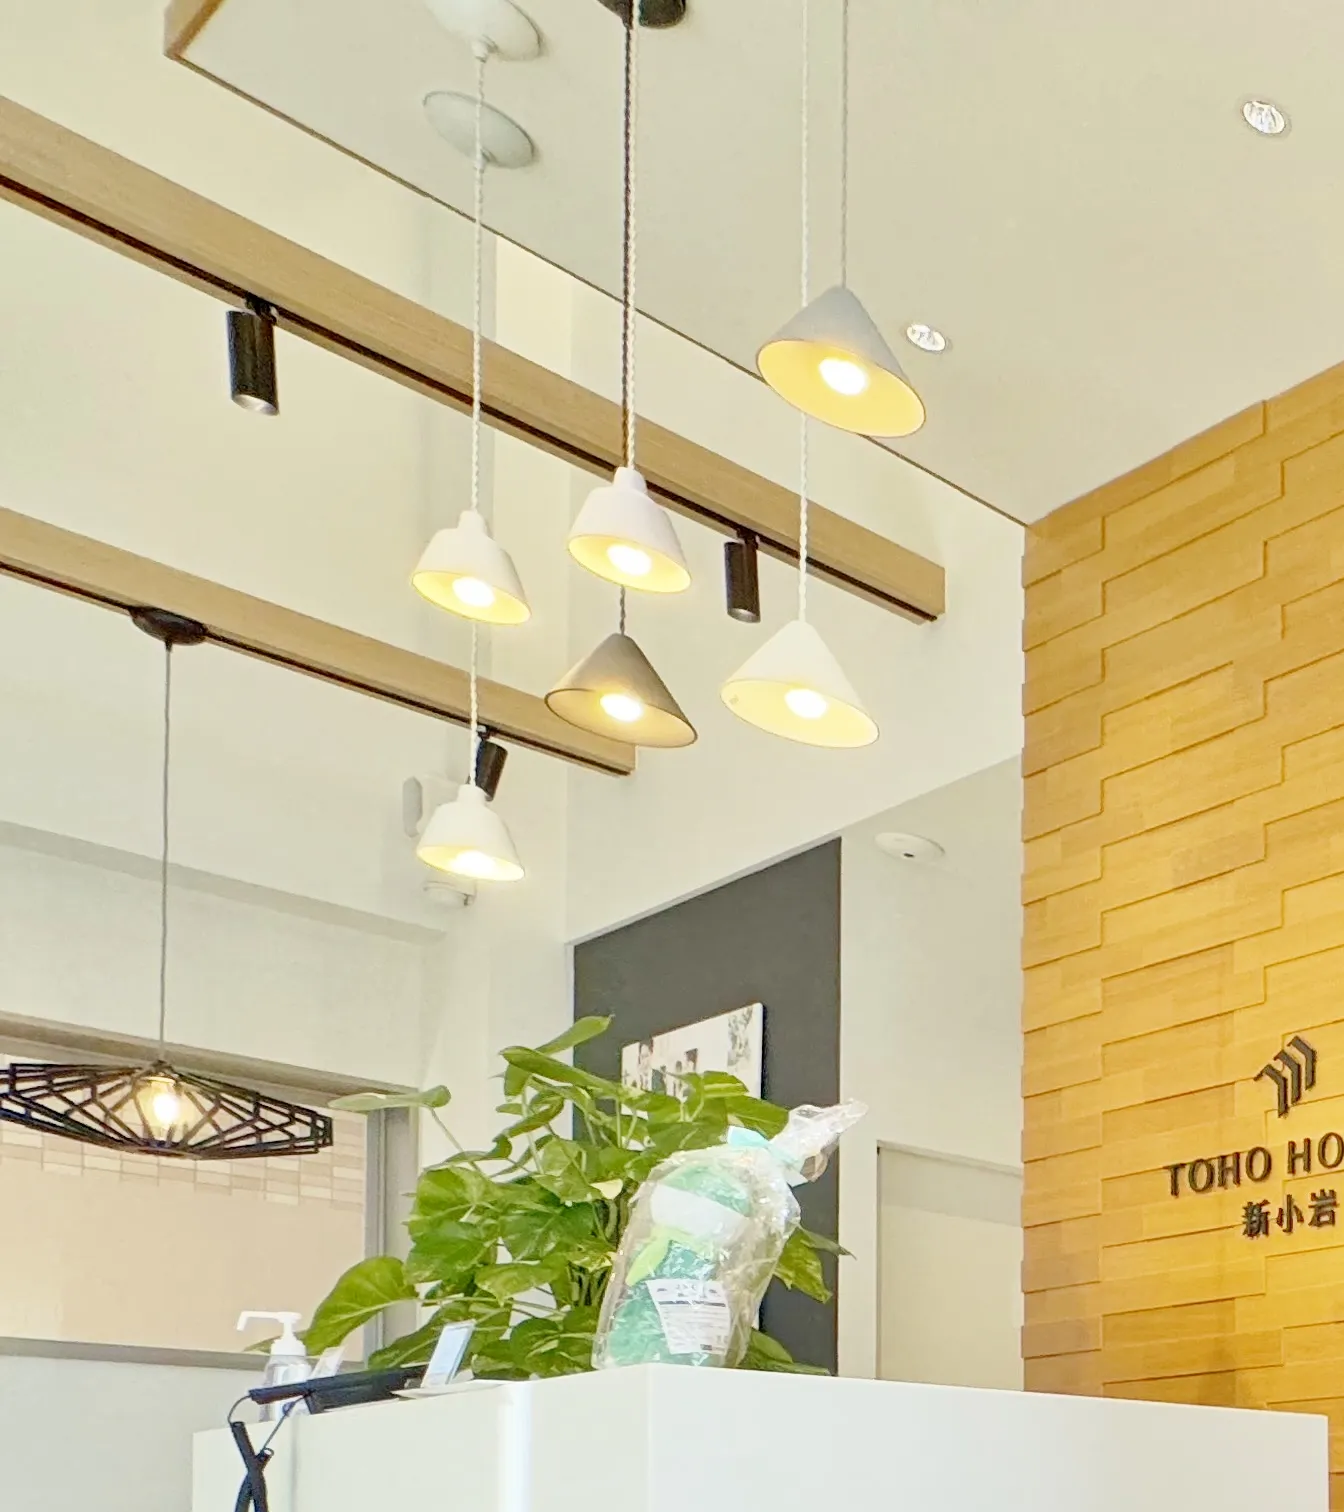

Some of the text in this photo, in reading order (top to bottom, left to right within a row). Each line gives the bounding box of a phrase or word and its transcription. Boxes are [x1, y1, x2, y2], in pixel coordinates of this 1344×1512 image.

[1163, 1146, 1272, 1197] TOHO
[1242, 1189, 1340, 1239] 新小岩
